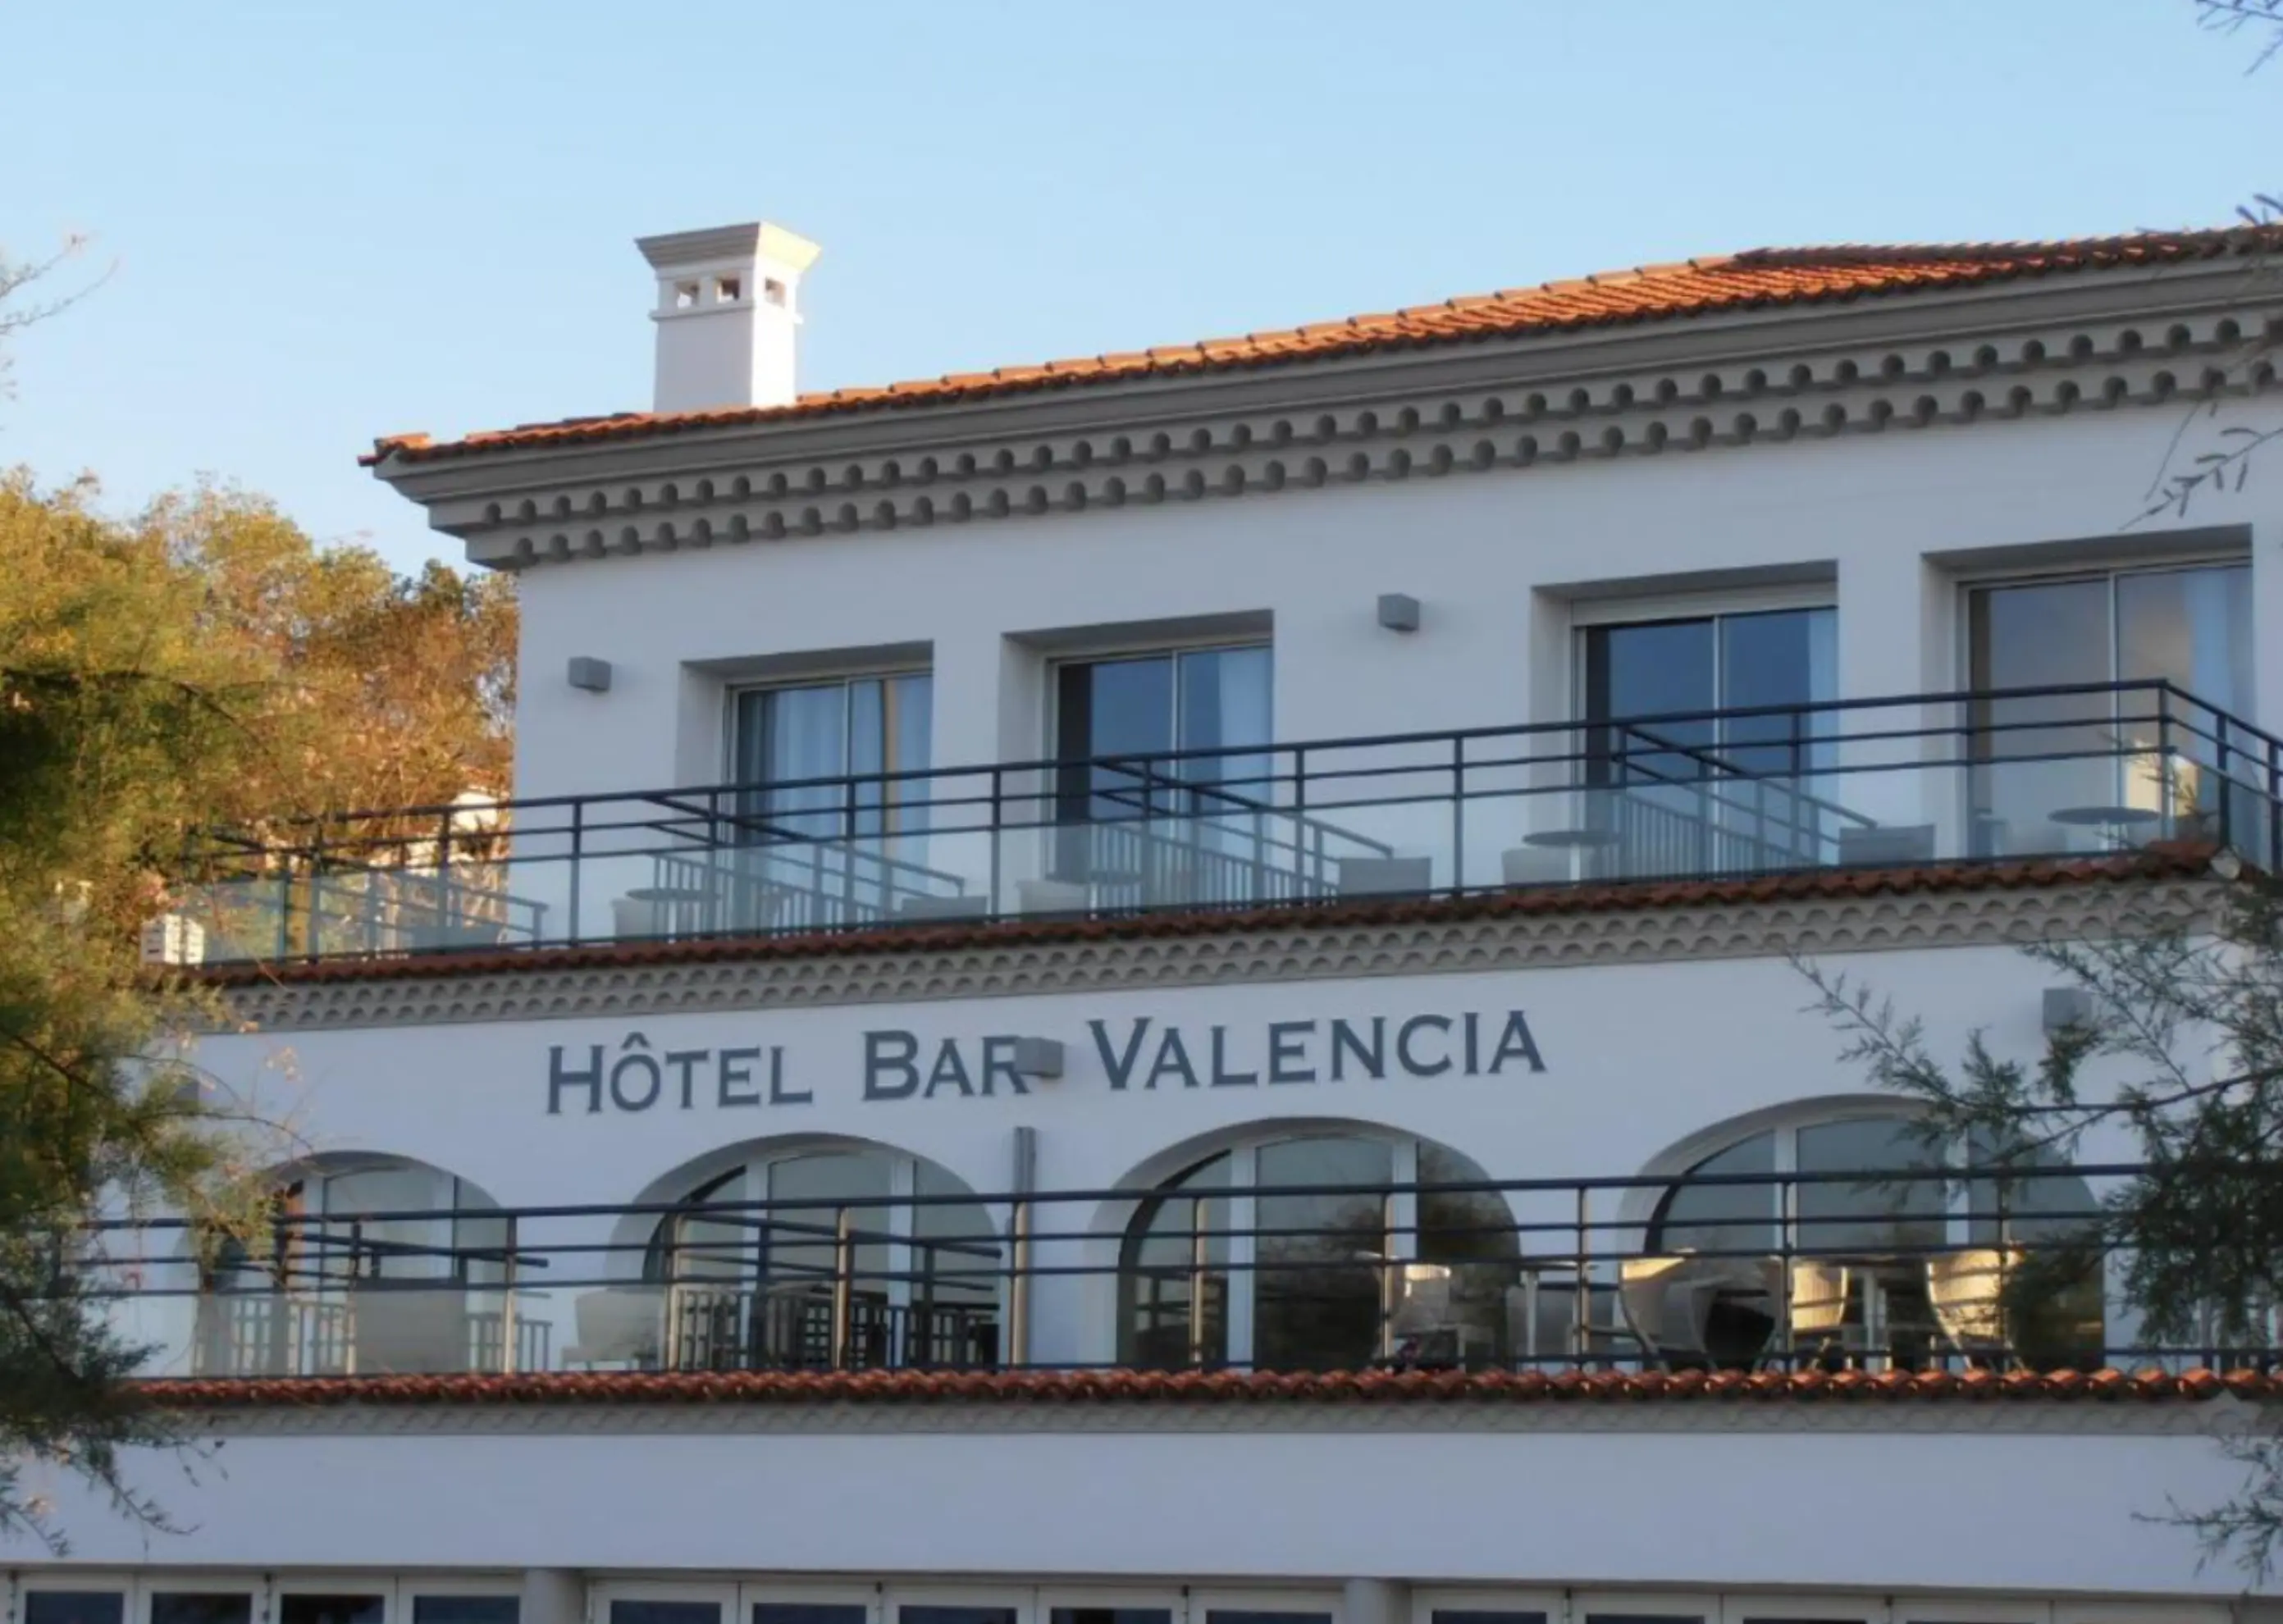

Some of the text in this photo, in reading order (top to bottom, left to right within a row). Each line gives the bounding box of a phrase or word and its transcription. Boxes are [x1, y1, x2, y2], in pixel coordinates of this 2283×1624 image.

[546, 1010, 1548, 1115] HÔTEL BAR VALENCIA
